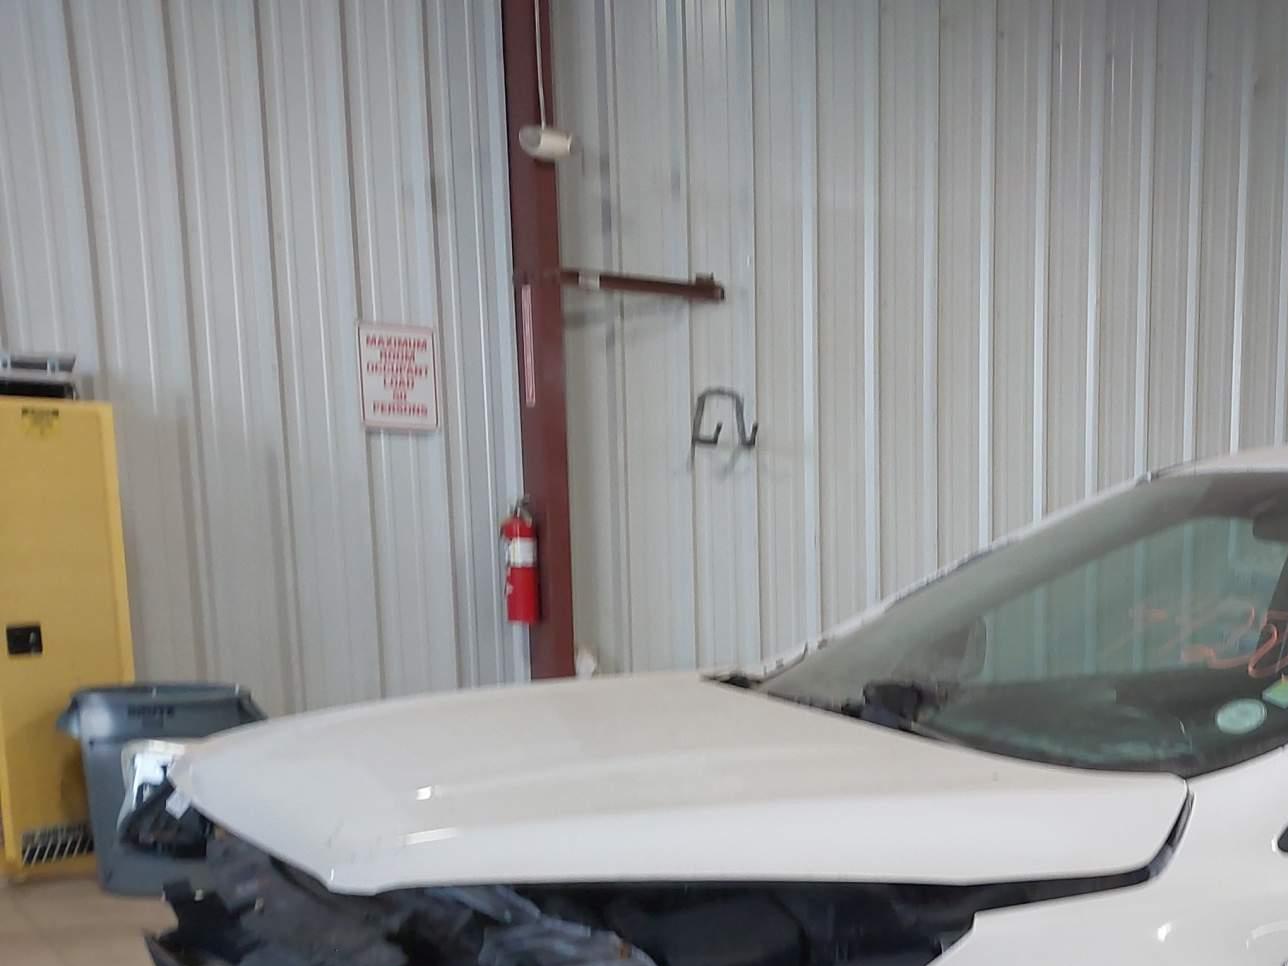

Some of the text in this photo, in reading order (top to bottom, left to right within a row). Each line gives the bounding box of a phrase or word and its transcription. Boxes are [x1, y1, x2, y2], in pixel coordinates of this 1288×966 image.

[366, 334, 428, 350] MAXIMUM
[380, 350, 416, 362] ROOM
[366, 362, 428, 377] OCCUPANT
[383, 376, 415, 390] LOAD
[372, 402, 428, 417] PERSONS
